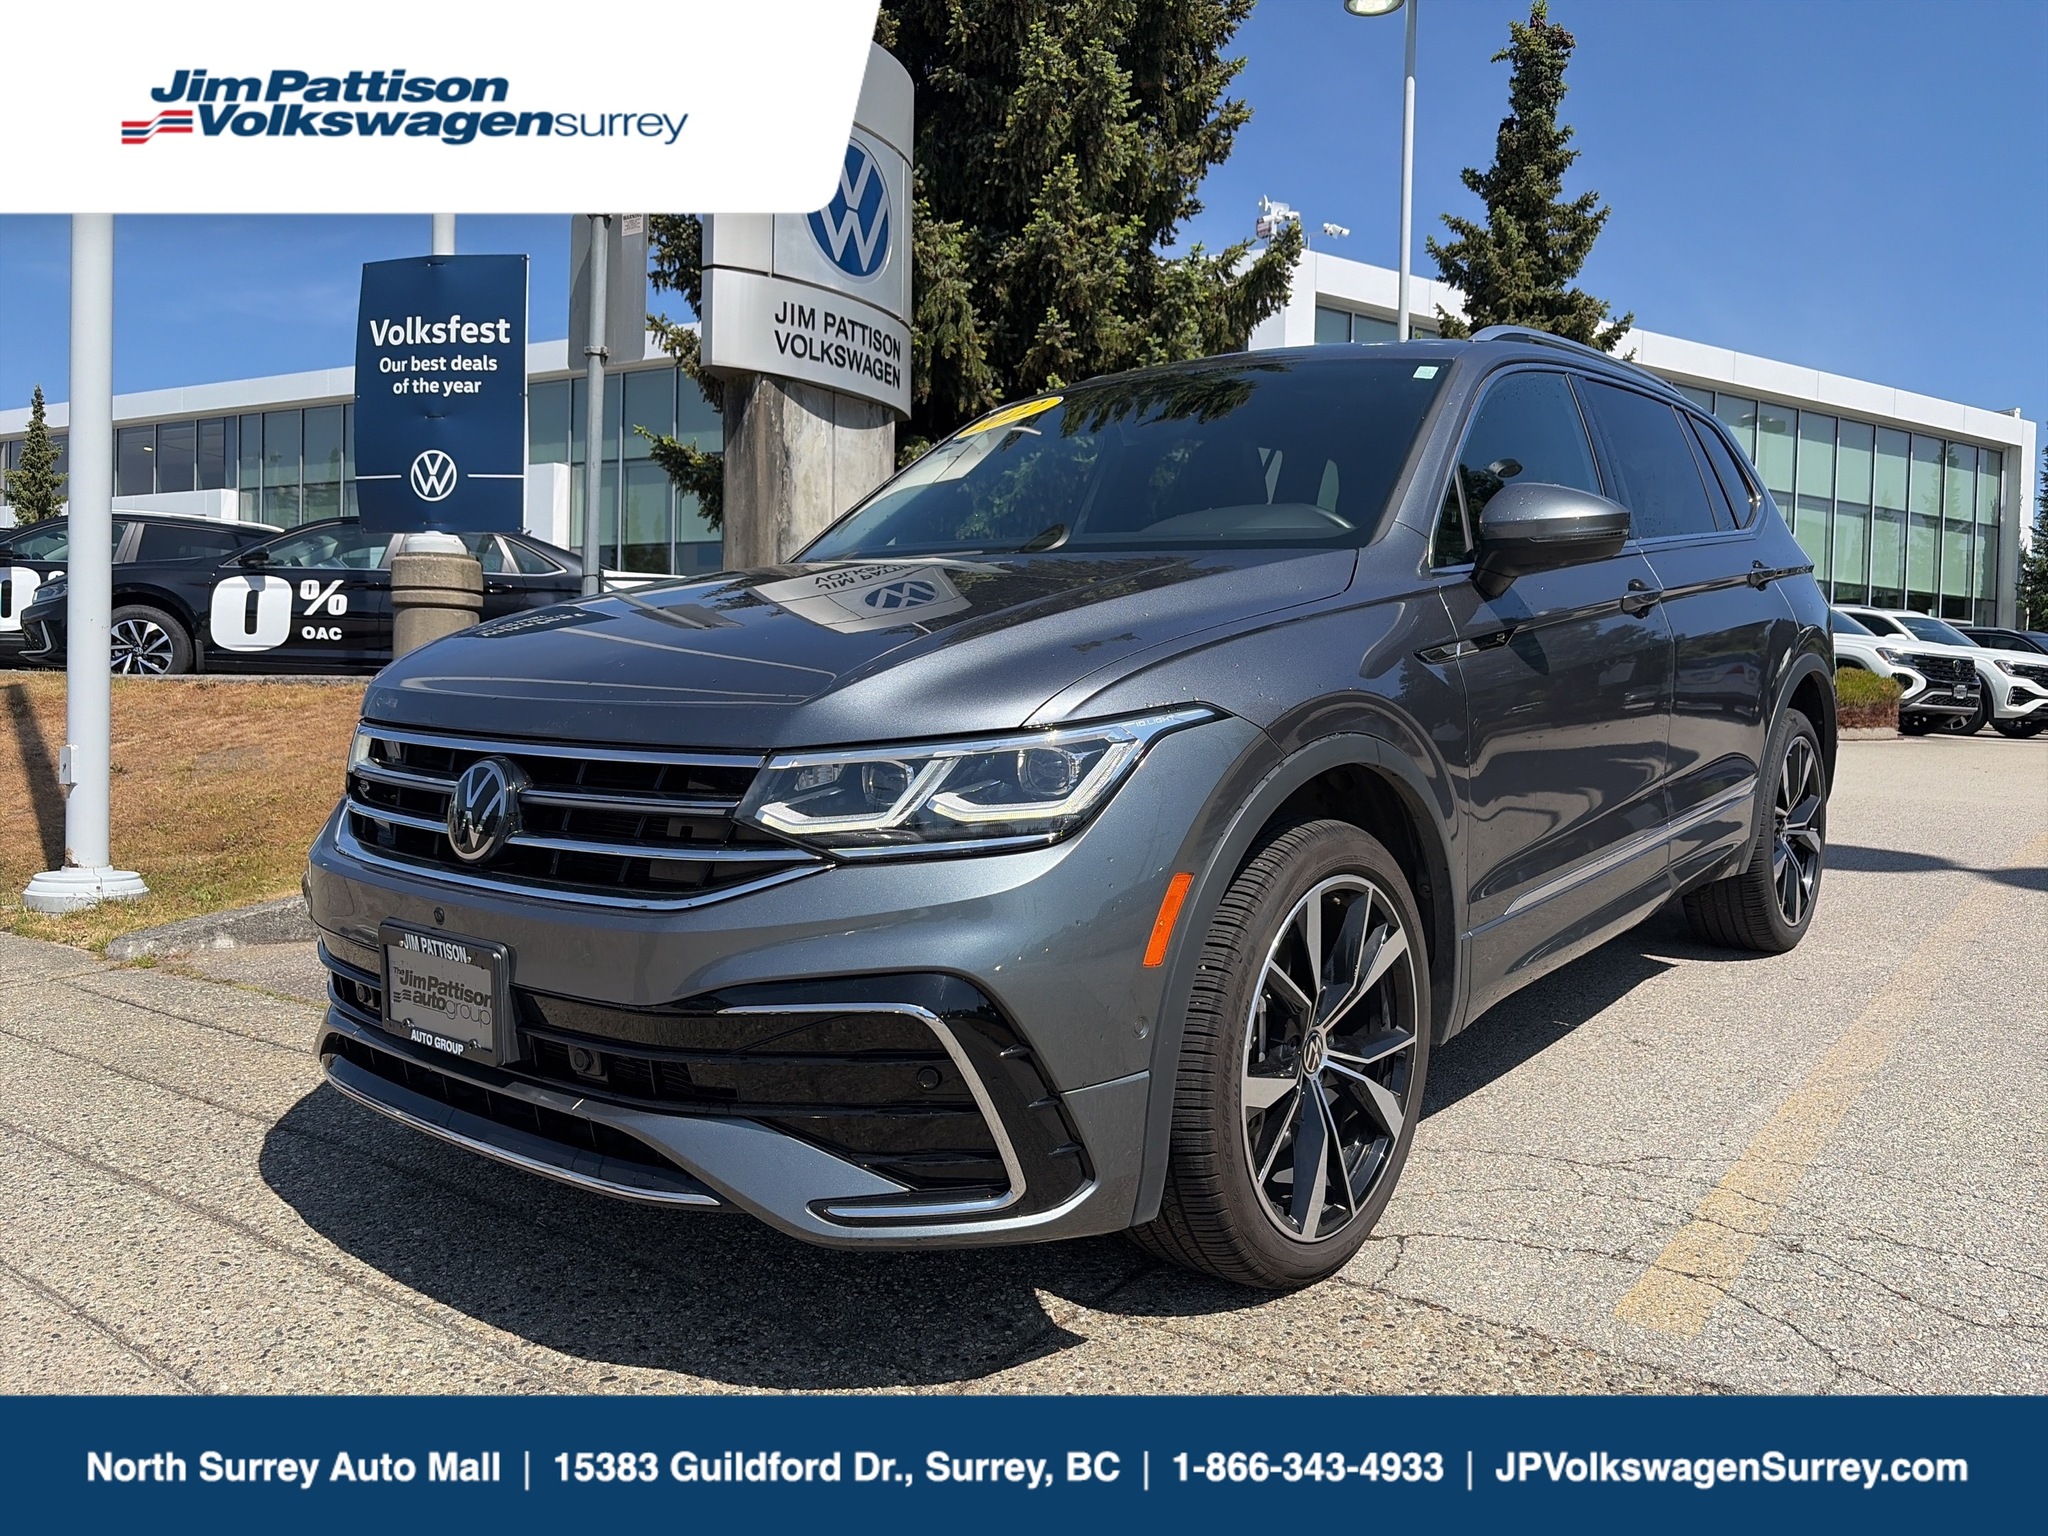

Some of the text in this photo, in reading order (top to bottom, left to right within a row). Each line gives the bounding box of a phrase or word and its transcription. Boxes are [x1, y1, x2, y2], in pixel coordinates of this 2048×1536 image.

[370, 315, 510, 346] Volksfest
[775, 301, 900, 362] JIM PATTISON
[379, 355, 498, 373] Our best deals
[774, 330, 900, 390] VOLKSWAGEN
[393, 377, 482, 397] of the year
[301, 626, 343, 641] OAC
[404, 933, 467, 963] JIM PATTISON
[393, 966, 405, 976] The
[411, 1029, 464, 1055] AUTO GROUP
